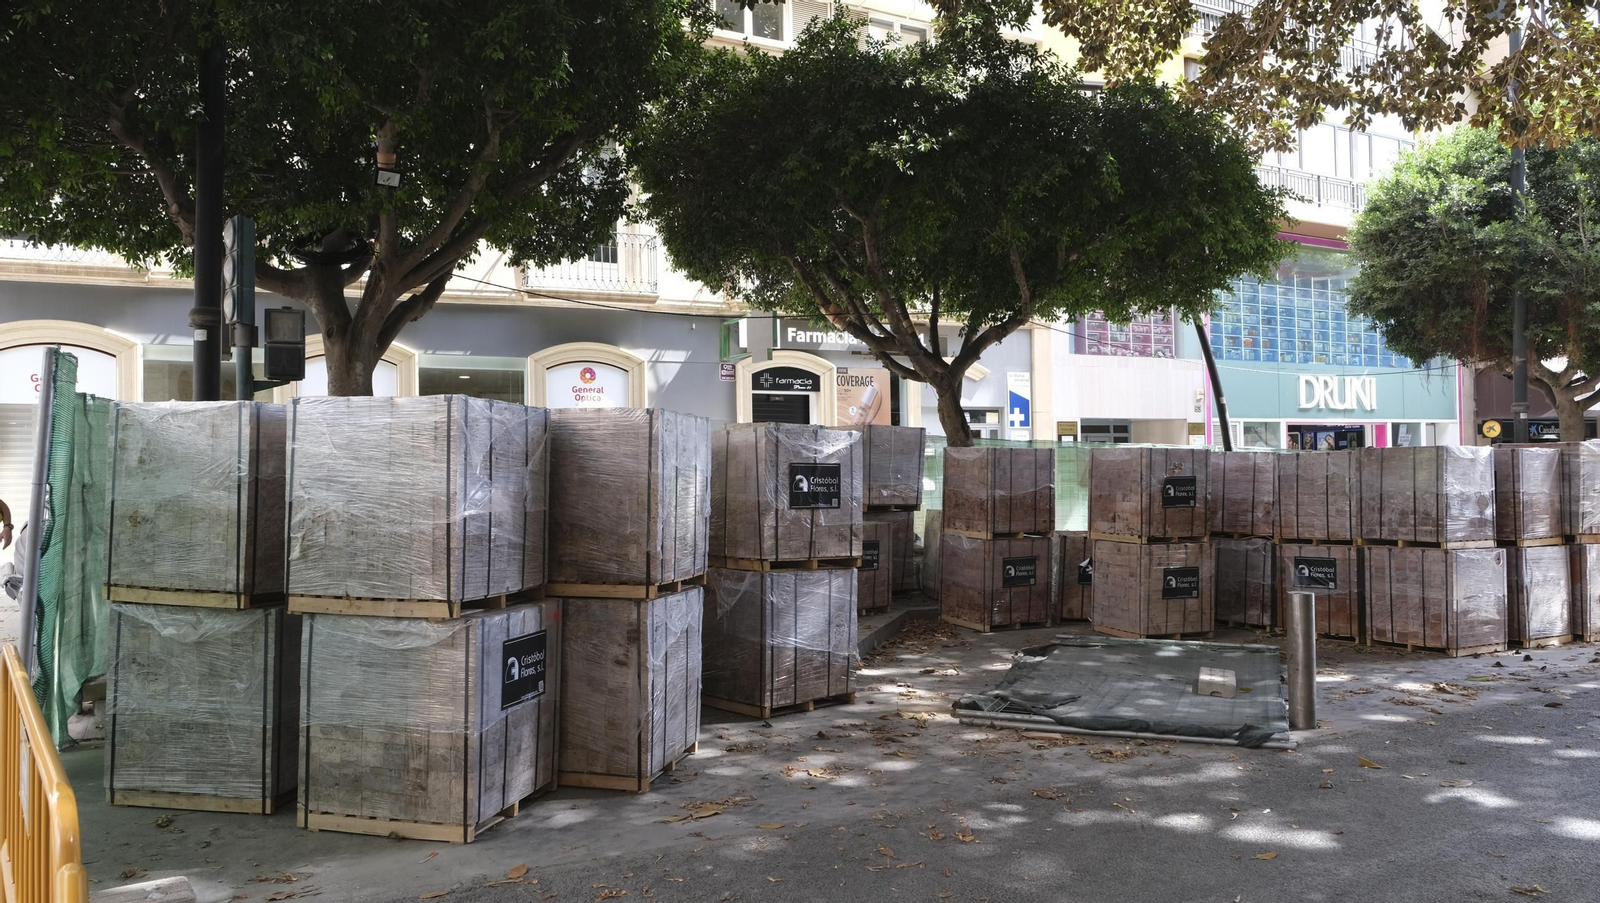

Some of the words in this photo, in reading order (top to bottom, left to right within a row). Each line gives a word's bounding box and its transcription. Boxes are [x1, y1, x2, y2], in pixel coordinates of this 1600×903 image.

[787, 327, 858, 345] Farmacia
[775, 377, 813, 385] farmacia
[836, 375, 875, 387] COVERAGE
[571, 386, 604, 394] General
[1298, 374, 1377, 411] DRUNI
[574, 393, 602, 403] Optica
[1538, 425, 1560, 434] CaixaBan
